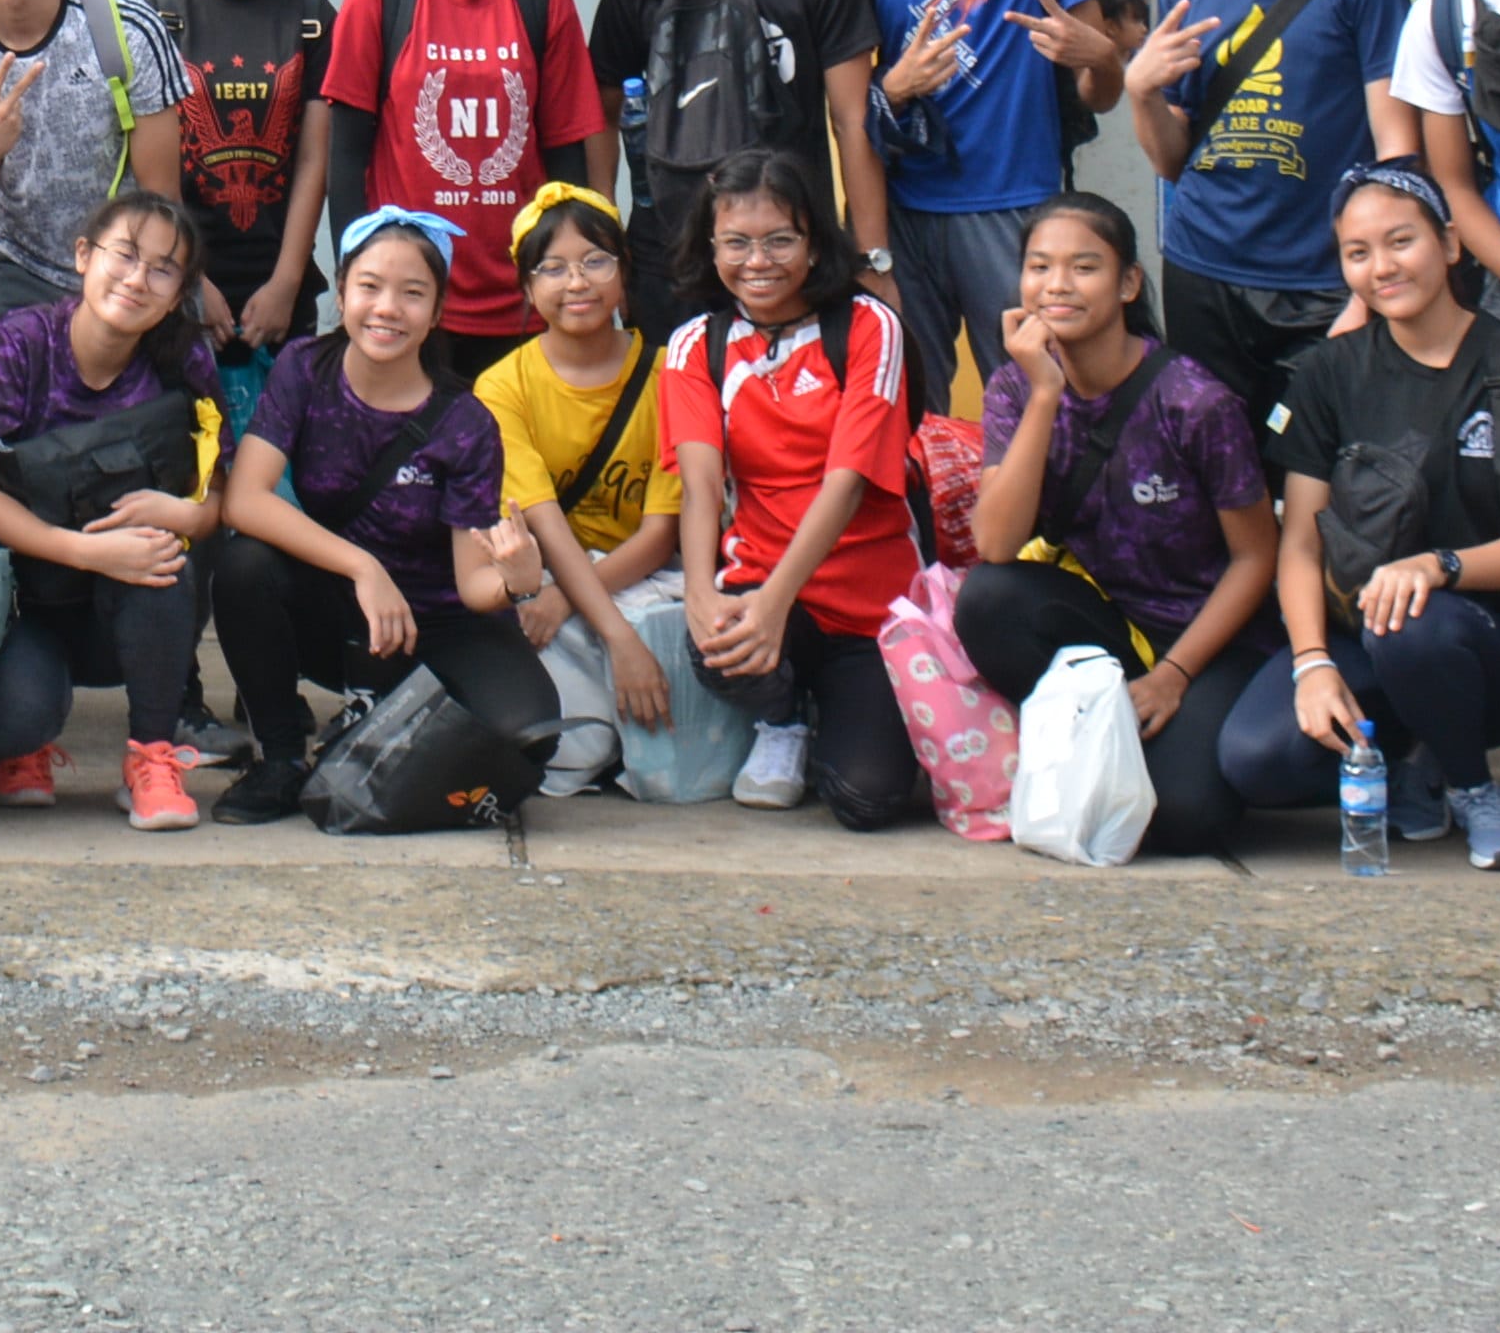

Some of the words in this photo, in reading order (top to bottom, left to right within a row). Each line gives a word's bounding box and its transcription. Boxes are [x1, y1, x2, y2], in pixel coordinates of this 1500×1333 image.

[426, 42, 487, 61] Class
[497, 41, 519, 60] of
[1229, 116, 1259, 131] ARE
[434, 190, 470, 205] 2017
[481, 190, 516, 205] 2018
